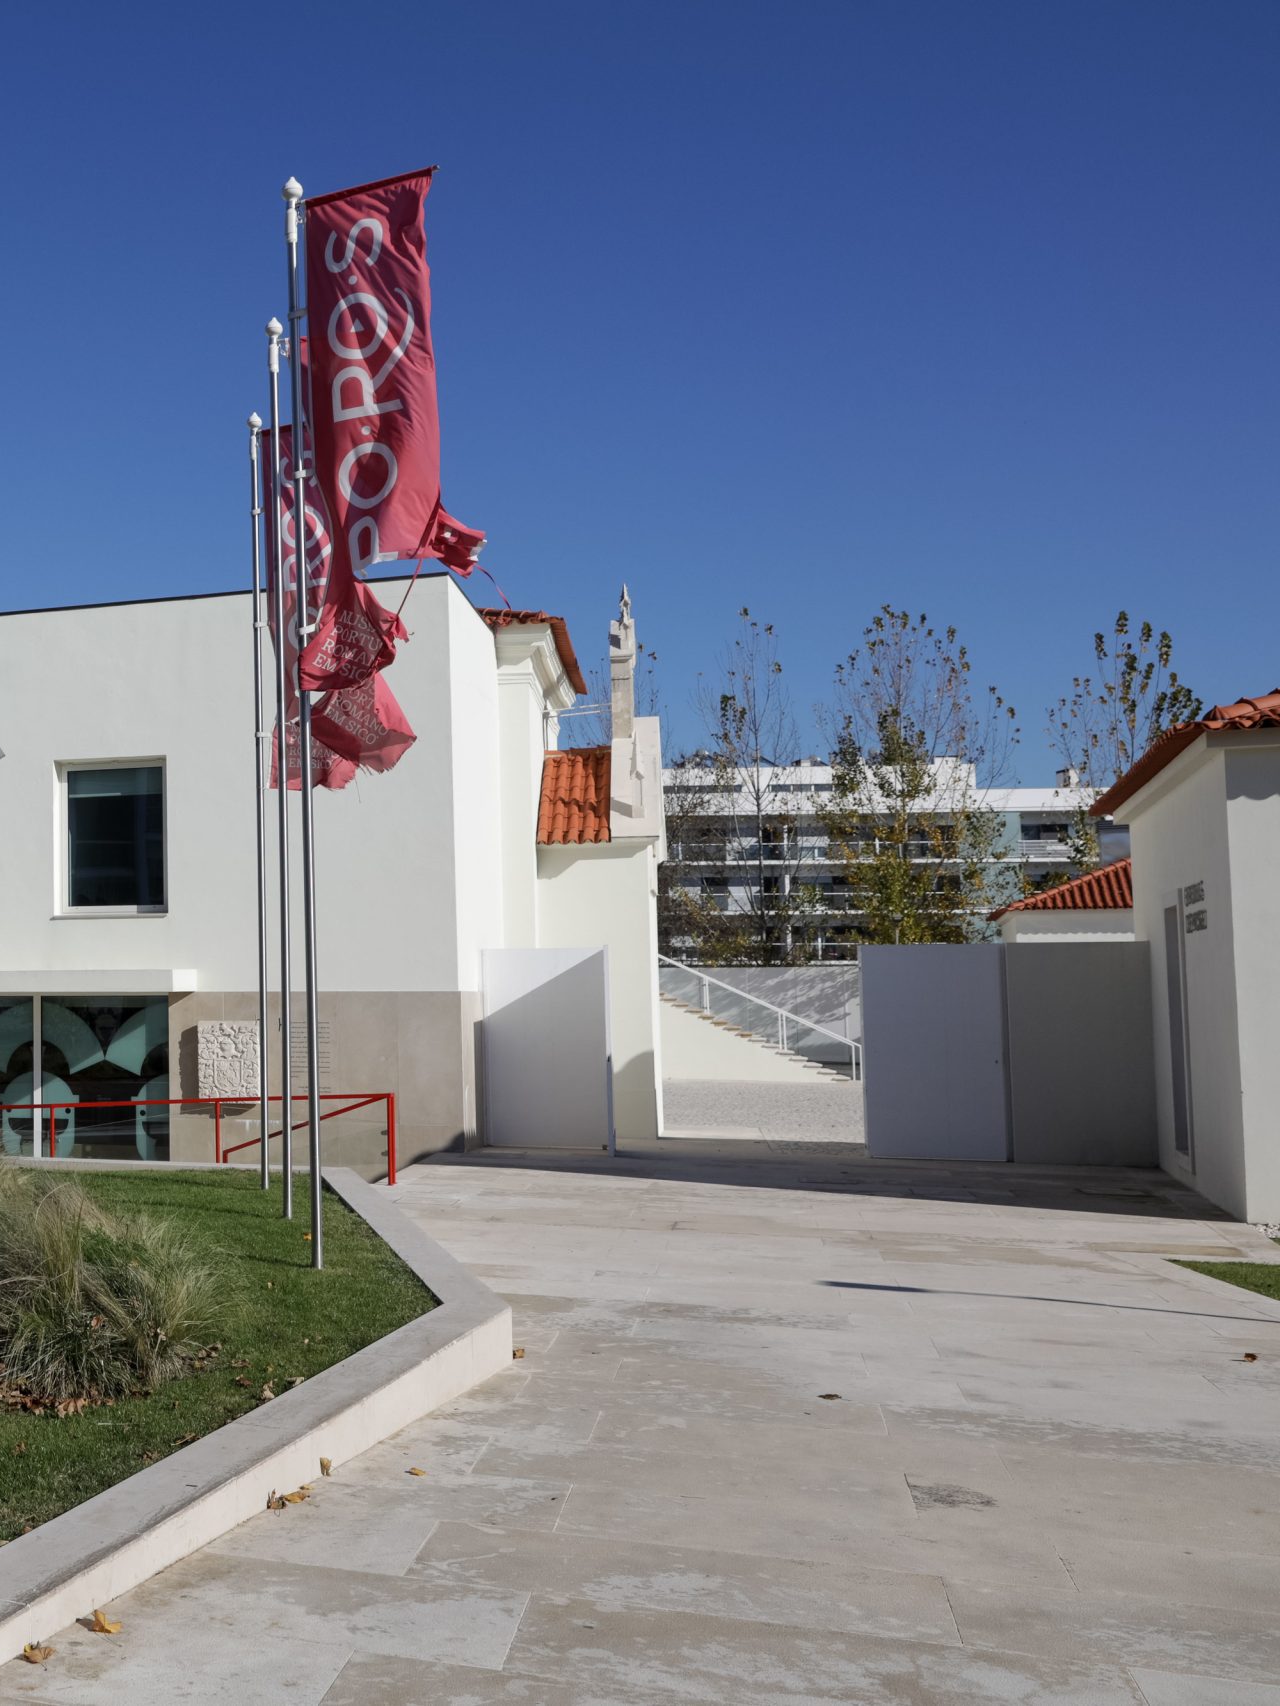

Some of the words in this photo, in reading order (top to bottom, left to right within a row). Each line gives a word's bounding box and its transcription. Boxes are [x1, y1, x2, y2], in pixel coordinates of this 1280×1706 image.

[330, 625, 383, 651] PORTU
[312, 652, 338, 672] EM
[338, 662, 368, 681] SIC
[323, 705, 346, 725] EM
